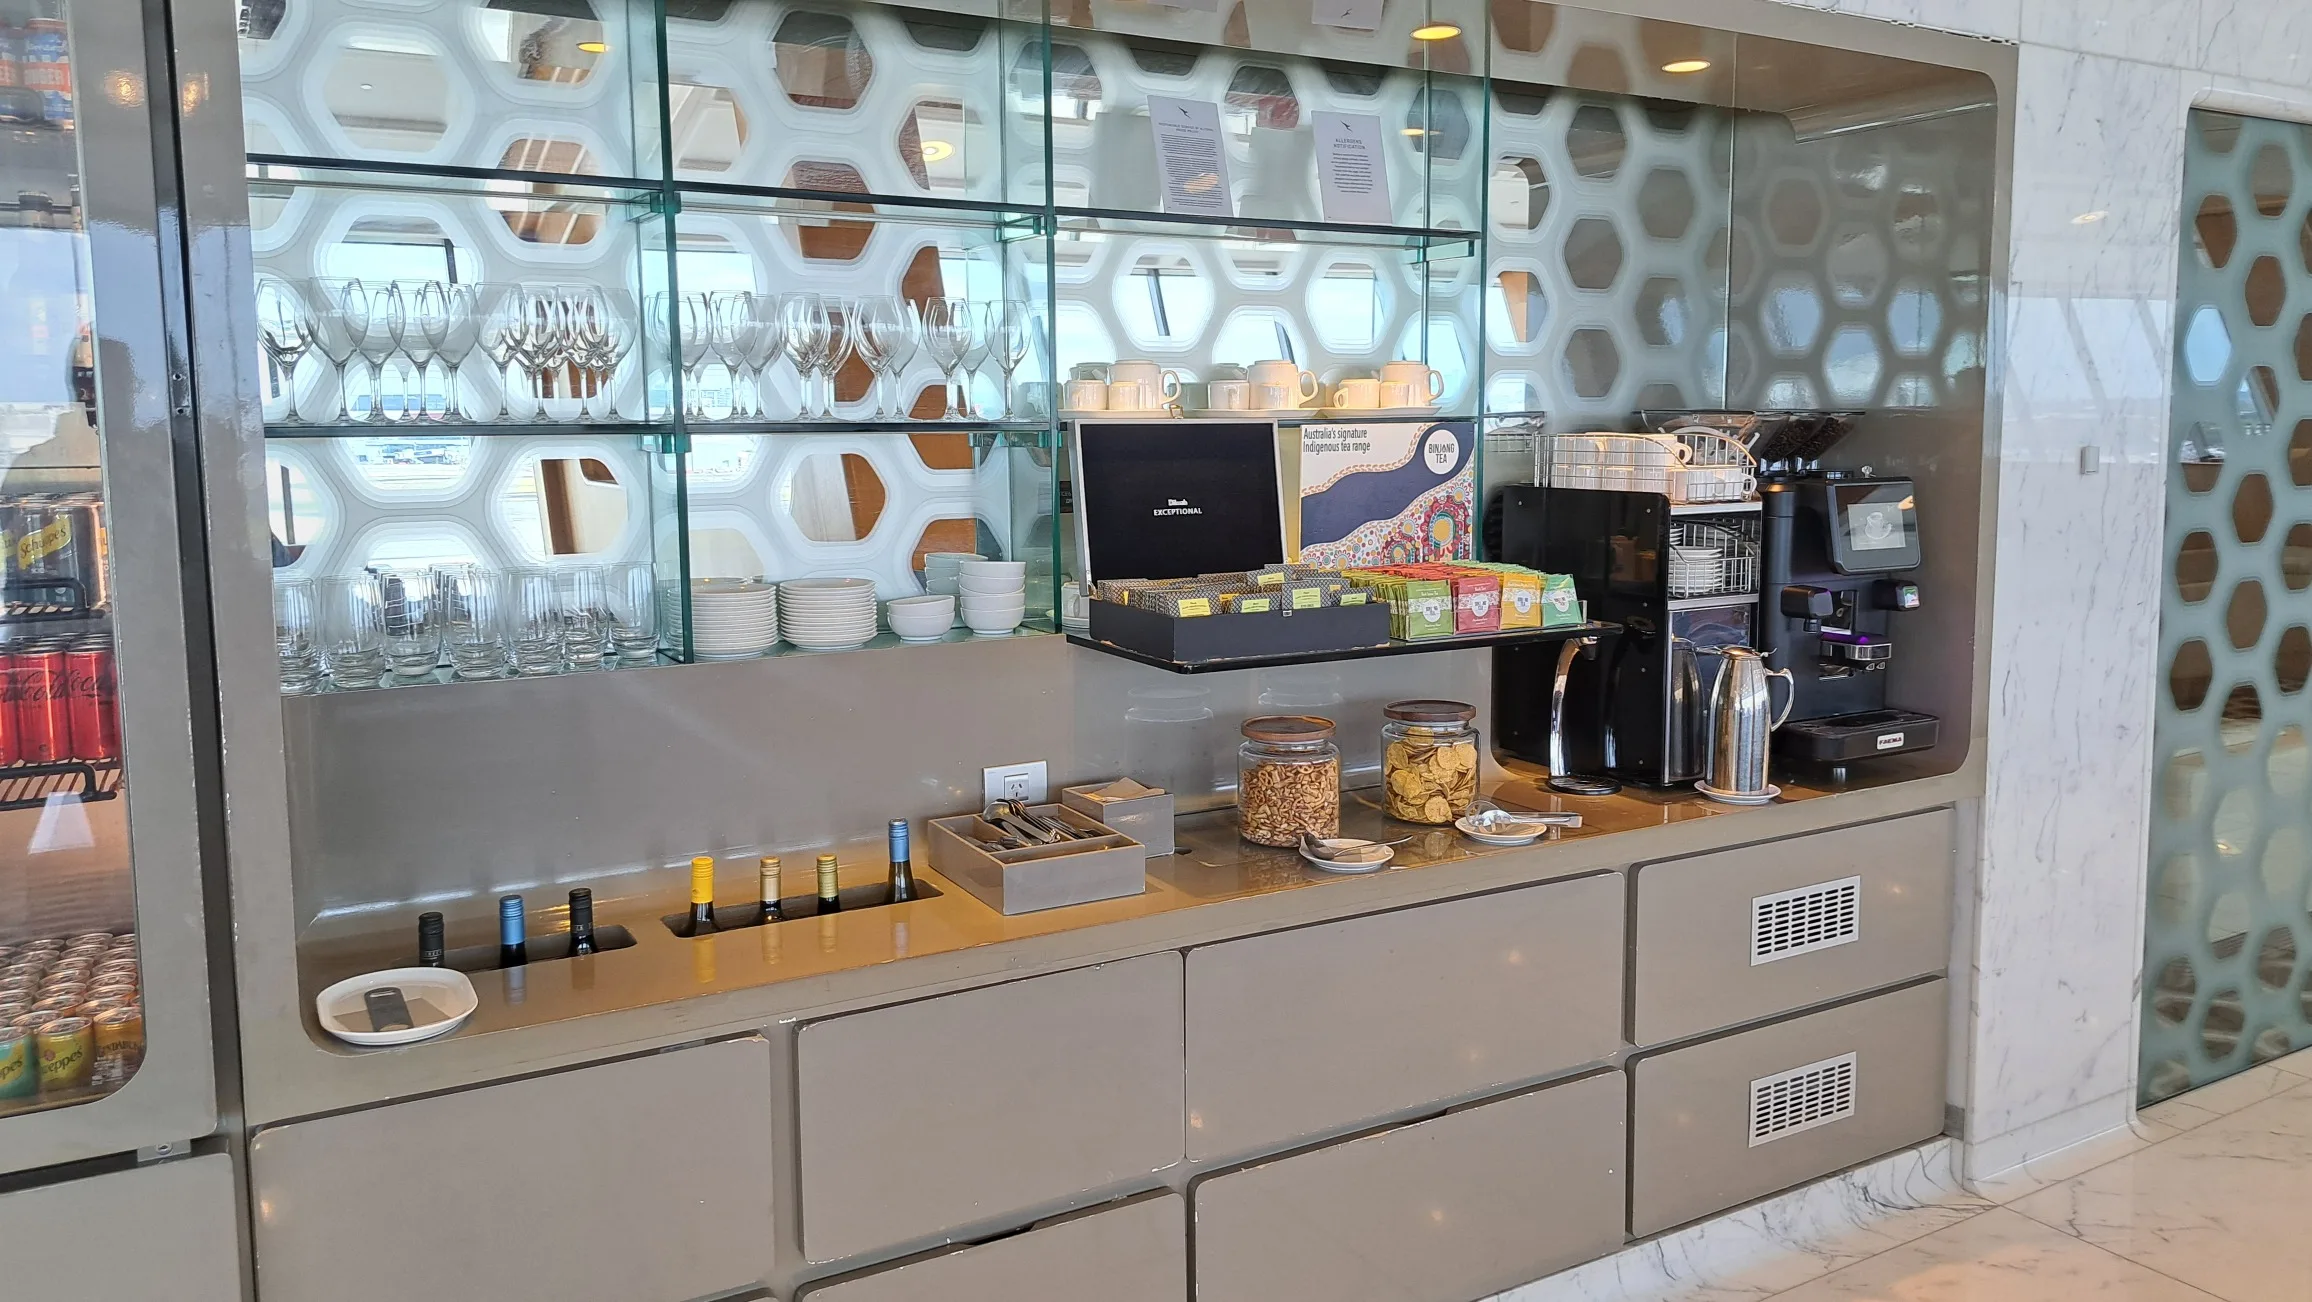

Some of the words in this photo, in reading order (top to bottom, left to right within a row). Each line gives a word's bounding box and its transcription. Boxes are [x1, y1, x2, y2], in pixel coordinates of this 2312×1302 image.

[1303, 427, 1336, 440] Australia's
[1337, 428, 1368, 441] signature
[1303, 441, 1340, 455] Indigenous
[1341, 441, 1351, 452] tea
[1351, 442, 1371, 454] range
[1435, 453, 1448, 464] TEA
[1153, 507, 1203, 516] EXCEPTIONAL
